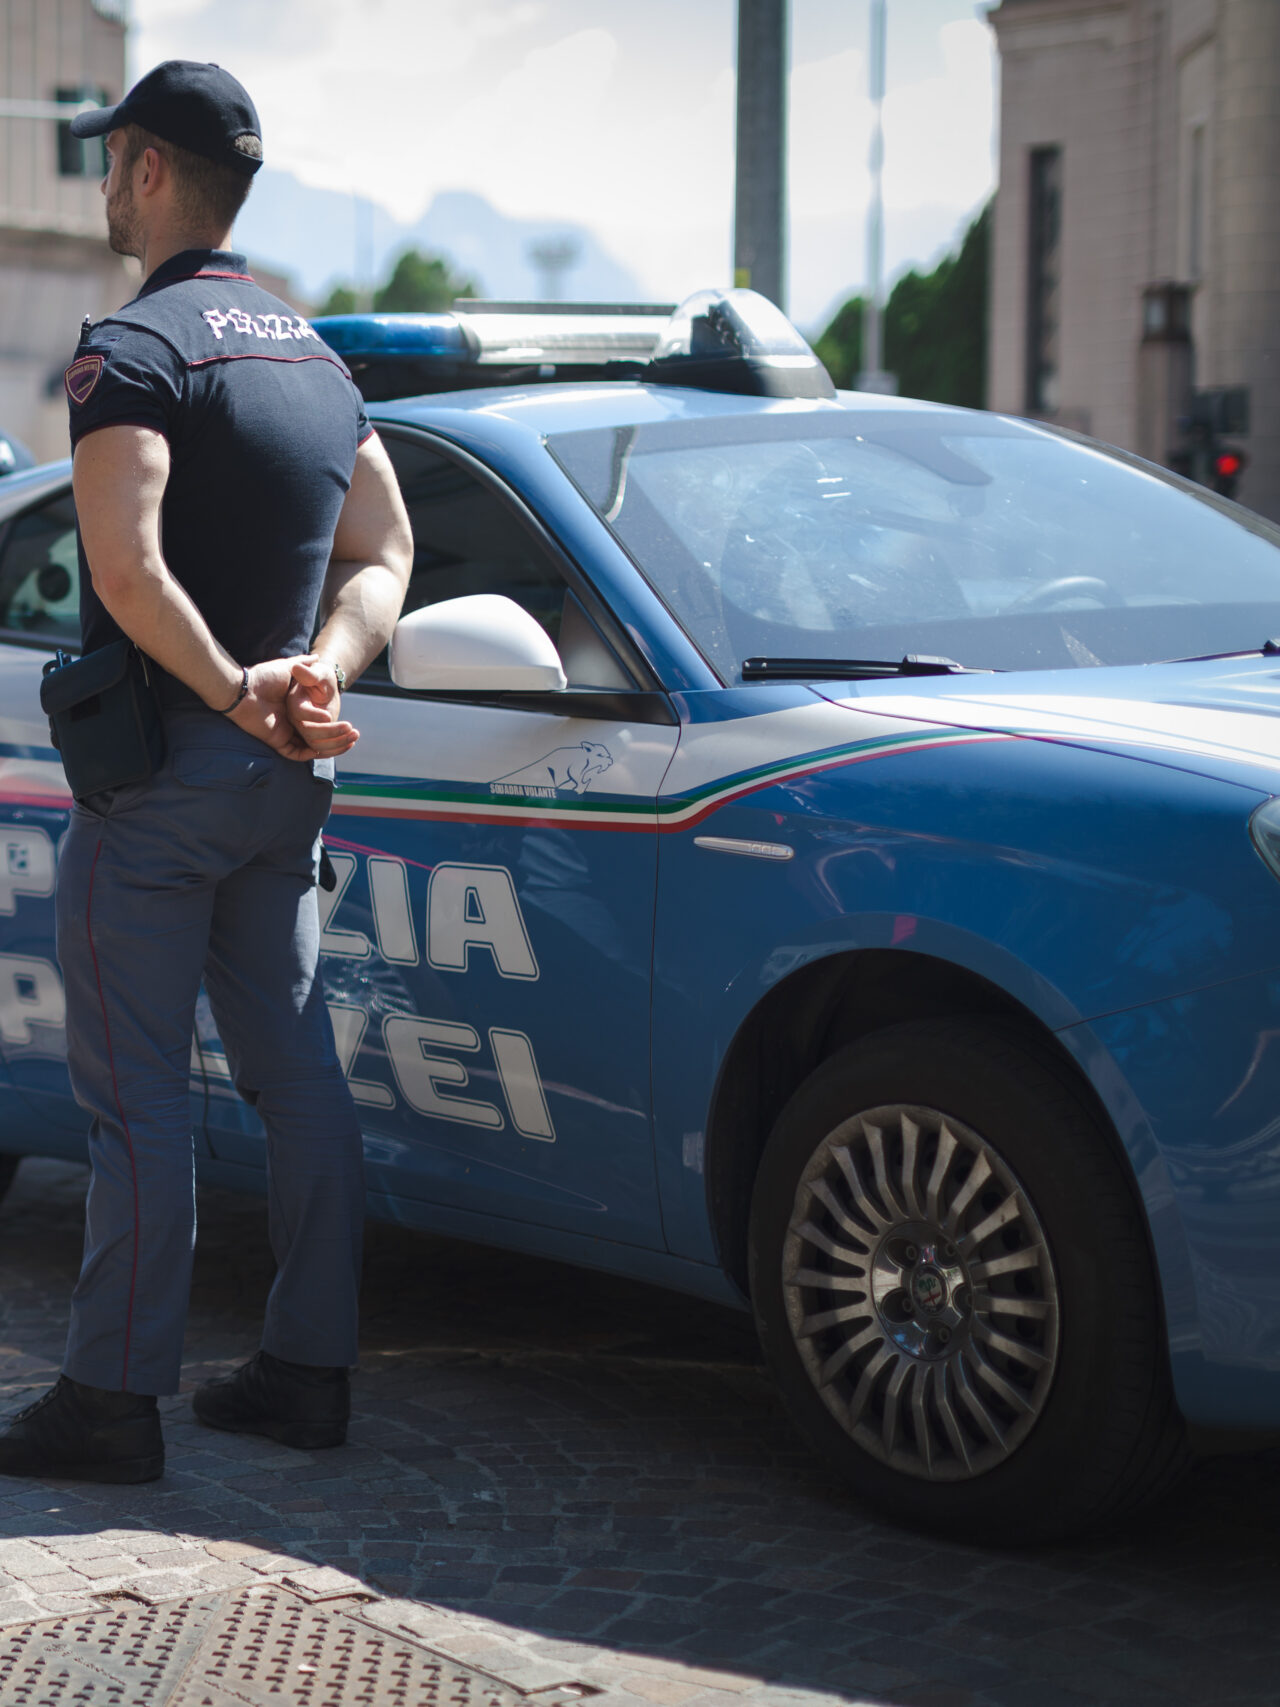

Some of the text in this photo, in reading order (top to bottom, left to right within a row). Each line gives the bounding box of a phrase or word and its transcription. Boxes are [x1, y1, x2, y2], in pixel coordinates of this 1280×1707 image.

[202, 308, 320, 341] POLIZIA
[490, 783, 557, 799] SQUADRA VOLANTE
